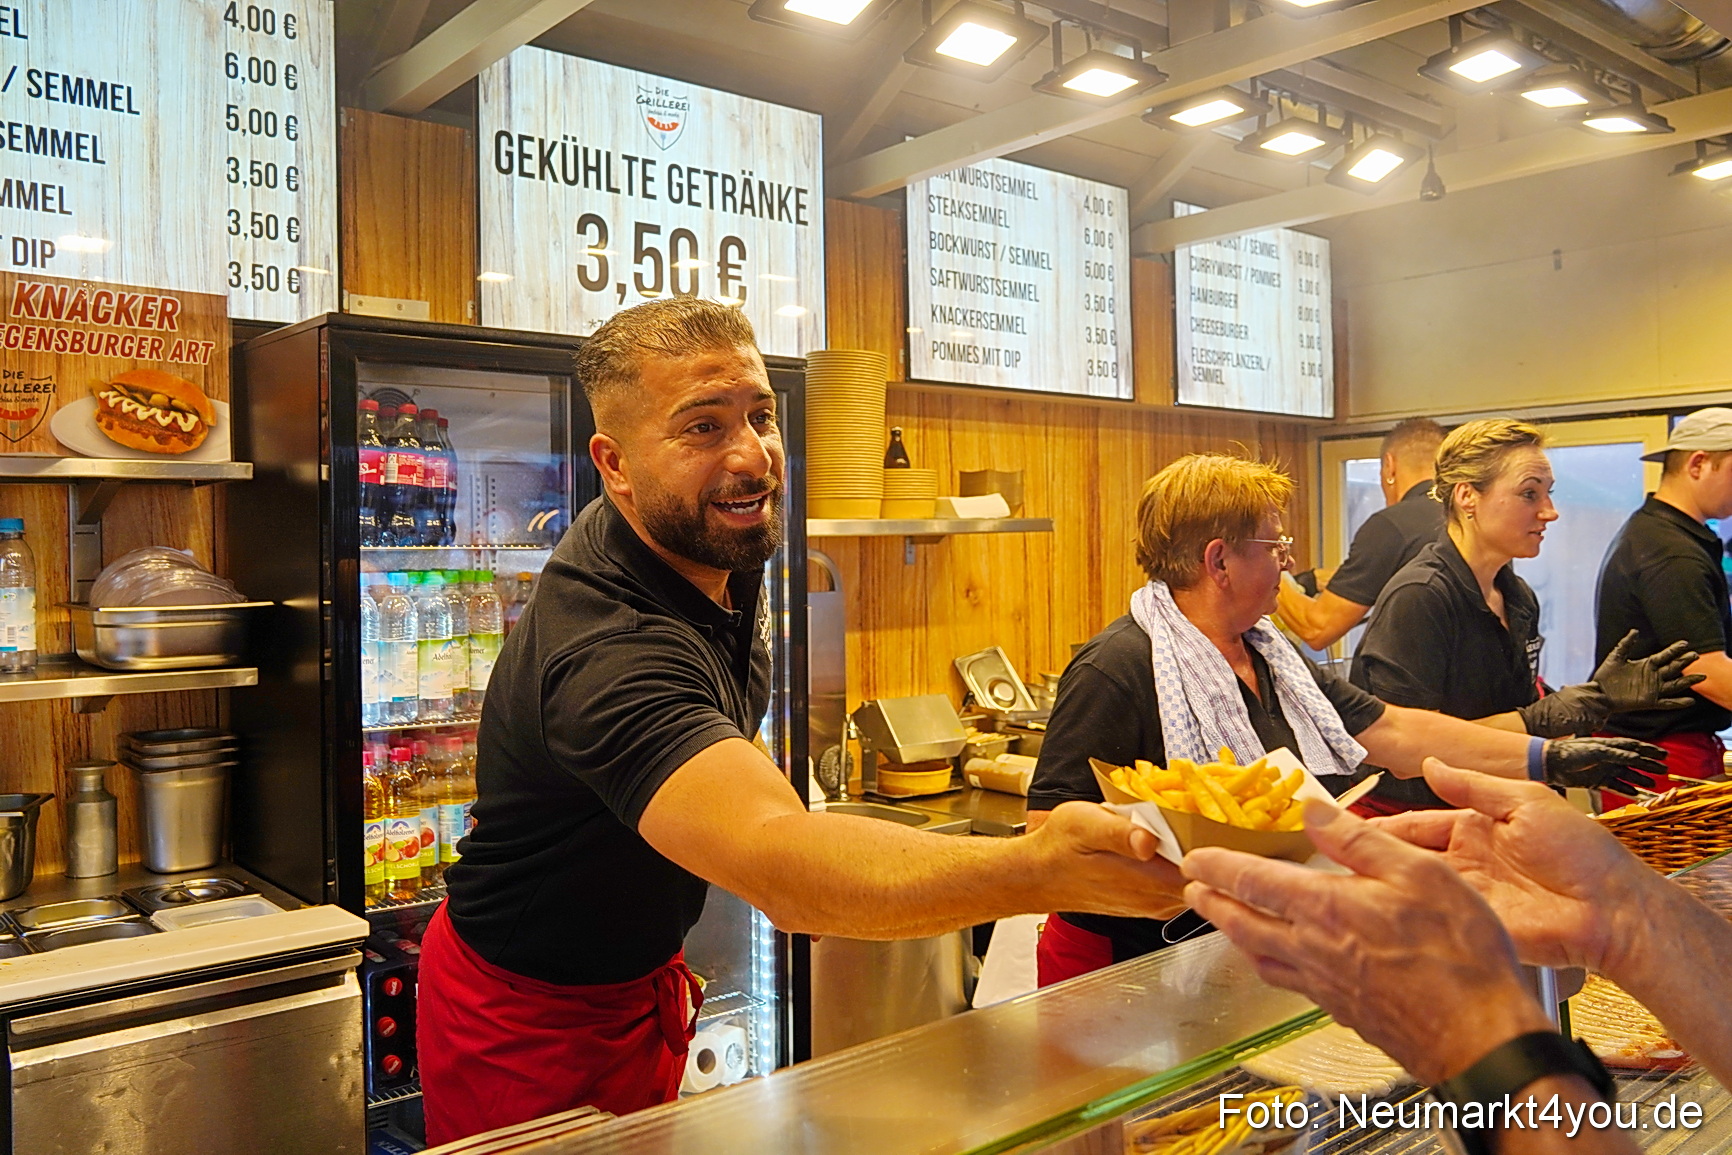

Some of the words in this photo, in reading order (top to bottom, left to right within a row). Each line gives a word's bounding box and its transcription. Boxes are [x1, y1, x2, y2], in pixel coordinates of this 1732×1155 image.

[224, 1, 275, 35] 4,00
[283, 13, 296, 40] €
[225, 52, 277, 86] 6,00
[284, 64, 298, 91] €
[27, 68, 140, 116] SEMMEL
[226, 104, 278, 138] 5,00
[285, 115, 299, 141] €
[636, 95, 690, 111] GRILLEREI
[656, 87, 669, 97] DIE
[226, 157, 278, 189] 3,50
[285, 166, 299, 192] €
[494, 130, 657, 201] GEKÜHLTE
[667, 163, 809, 227] GETRÄNKE
[227, 209, 279, 241] 3,50
[286, 217, 300, 243] €
[928, 194, 1010, 229] STEAKSEMMEL
[12, 236, 56, 269] DIP
[228, 261, 280, 293] 3,50
[287, 268, 300, 294] €
[576, 213, 699, 305] 3,50
[717, 235, 747, 307] €
[930, 230, 998, 261] BOCKWURST
[1009, 245, 1053, 271] SEMMEL
[930, 267, 1040, 303] SAFTWURSTSEMMEL
[931, 303, 1027, 335] KNACKERSEMMEL
[168, 338, 215, 365] ART
[932, 340, 979, 364] POMMES
[982, 347, 1001, 367] MIT
[1004, 350, 1021, 368] DIP
[3, 369, 24, 379] DIE
